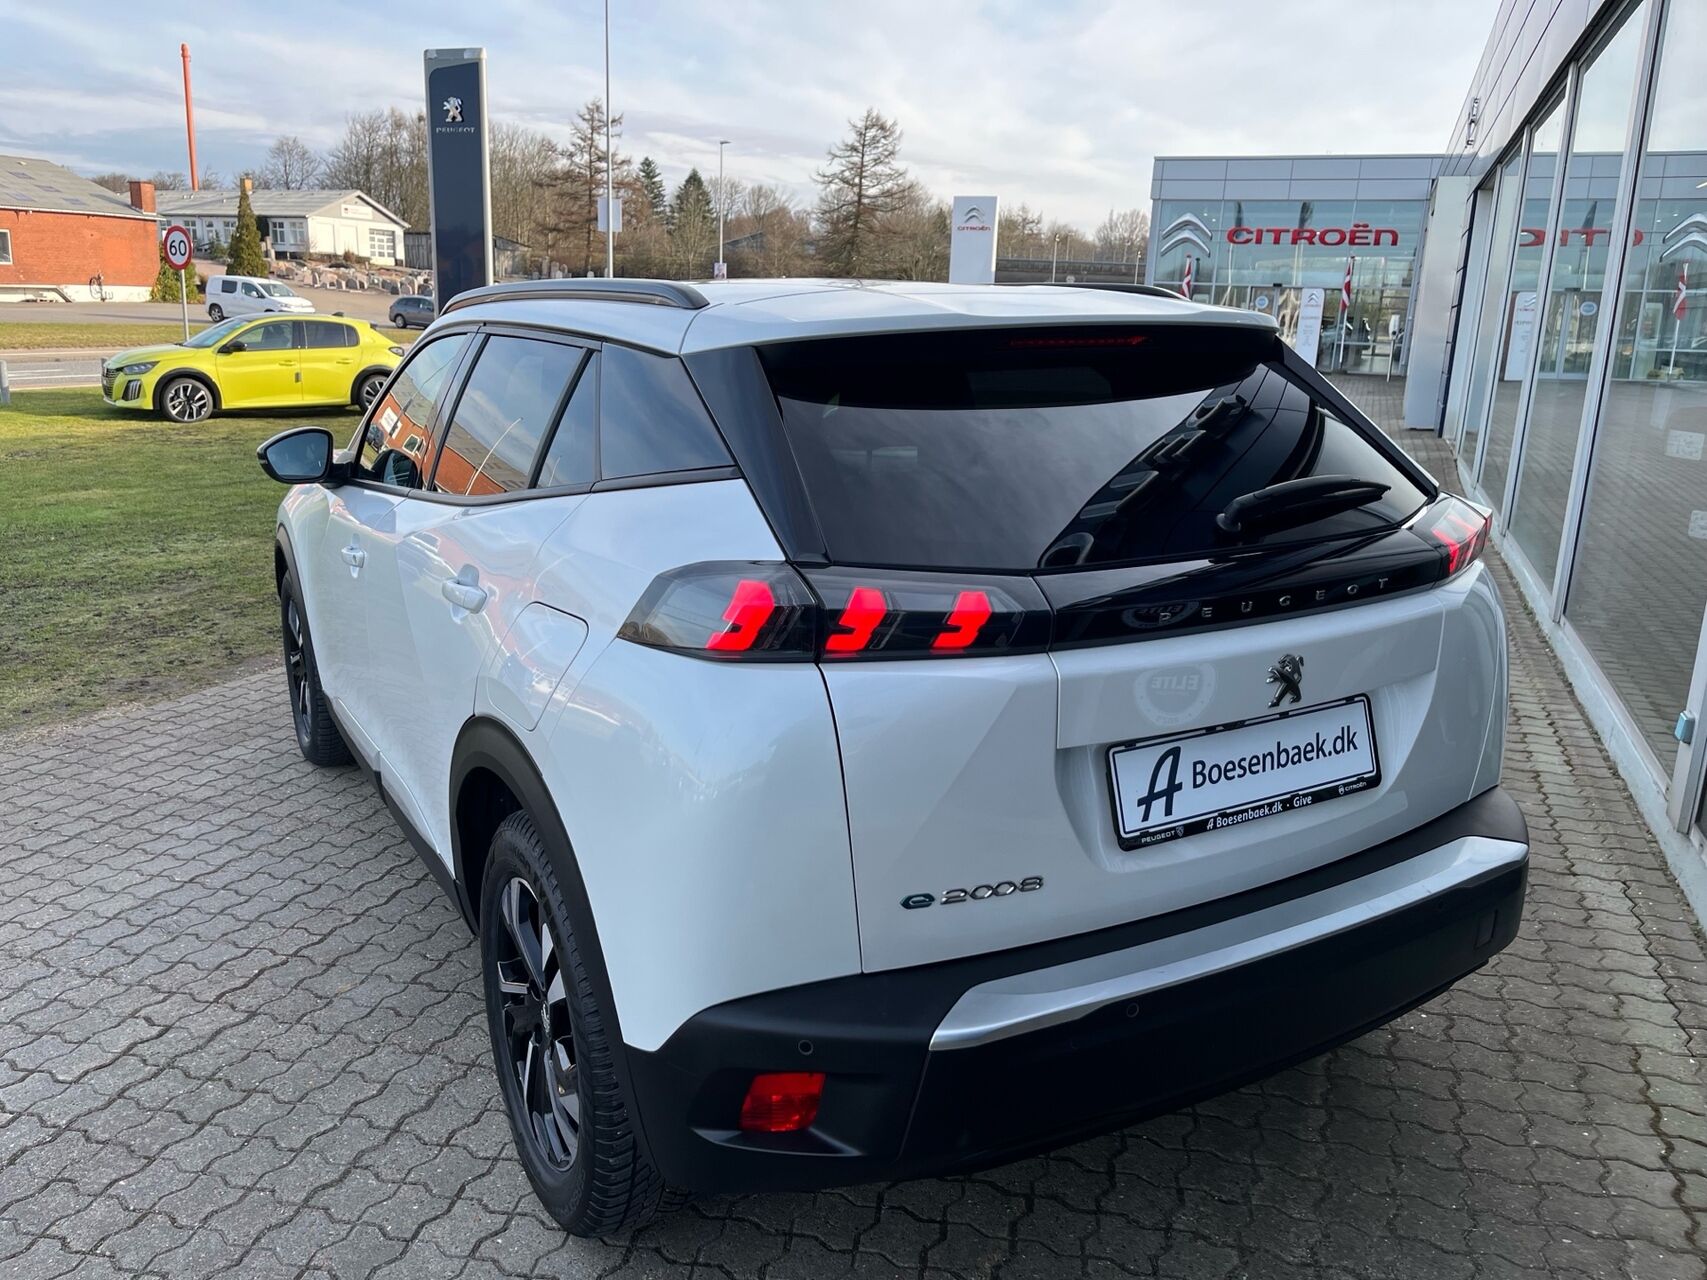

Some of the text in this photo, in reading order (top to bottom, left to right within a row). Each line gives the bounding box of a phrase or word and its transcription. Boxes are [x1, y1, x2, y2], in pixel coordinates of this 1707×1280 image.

[435, 126, 476, 134] PEUGEOT
[1226, 223, 1399, 246] CITROËN
[168, 239, 187, 257] 60
[1159, 578, 1388, 624] PEUGEOT
[1192, 725, 1358, 789] Boesenbaek.dk
[1345, 780, 1367, 792] CITROËN
[1216, 802, 1283, 828] Boesenbaek.dk
[1293, 794, 1312, 808] Give
[1141, 830, 1175, 844] PEUGEOT
[940, 875, 1044, 905] 2008
